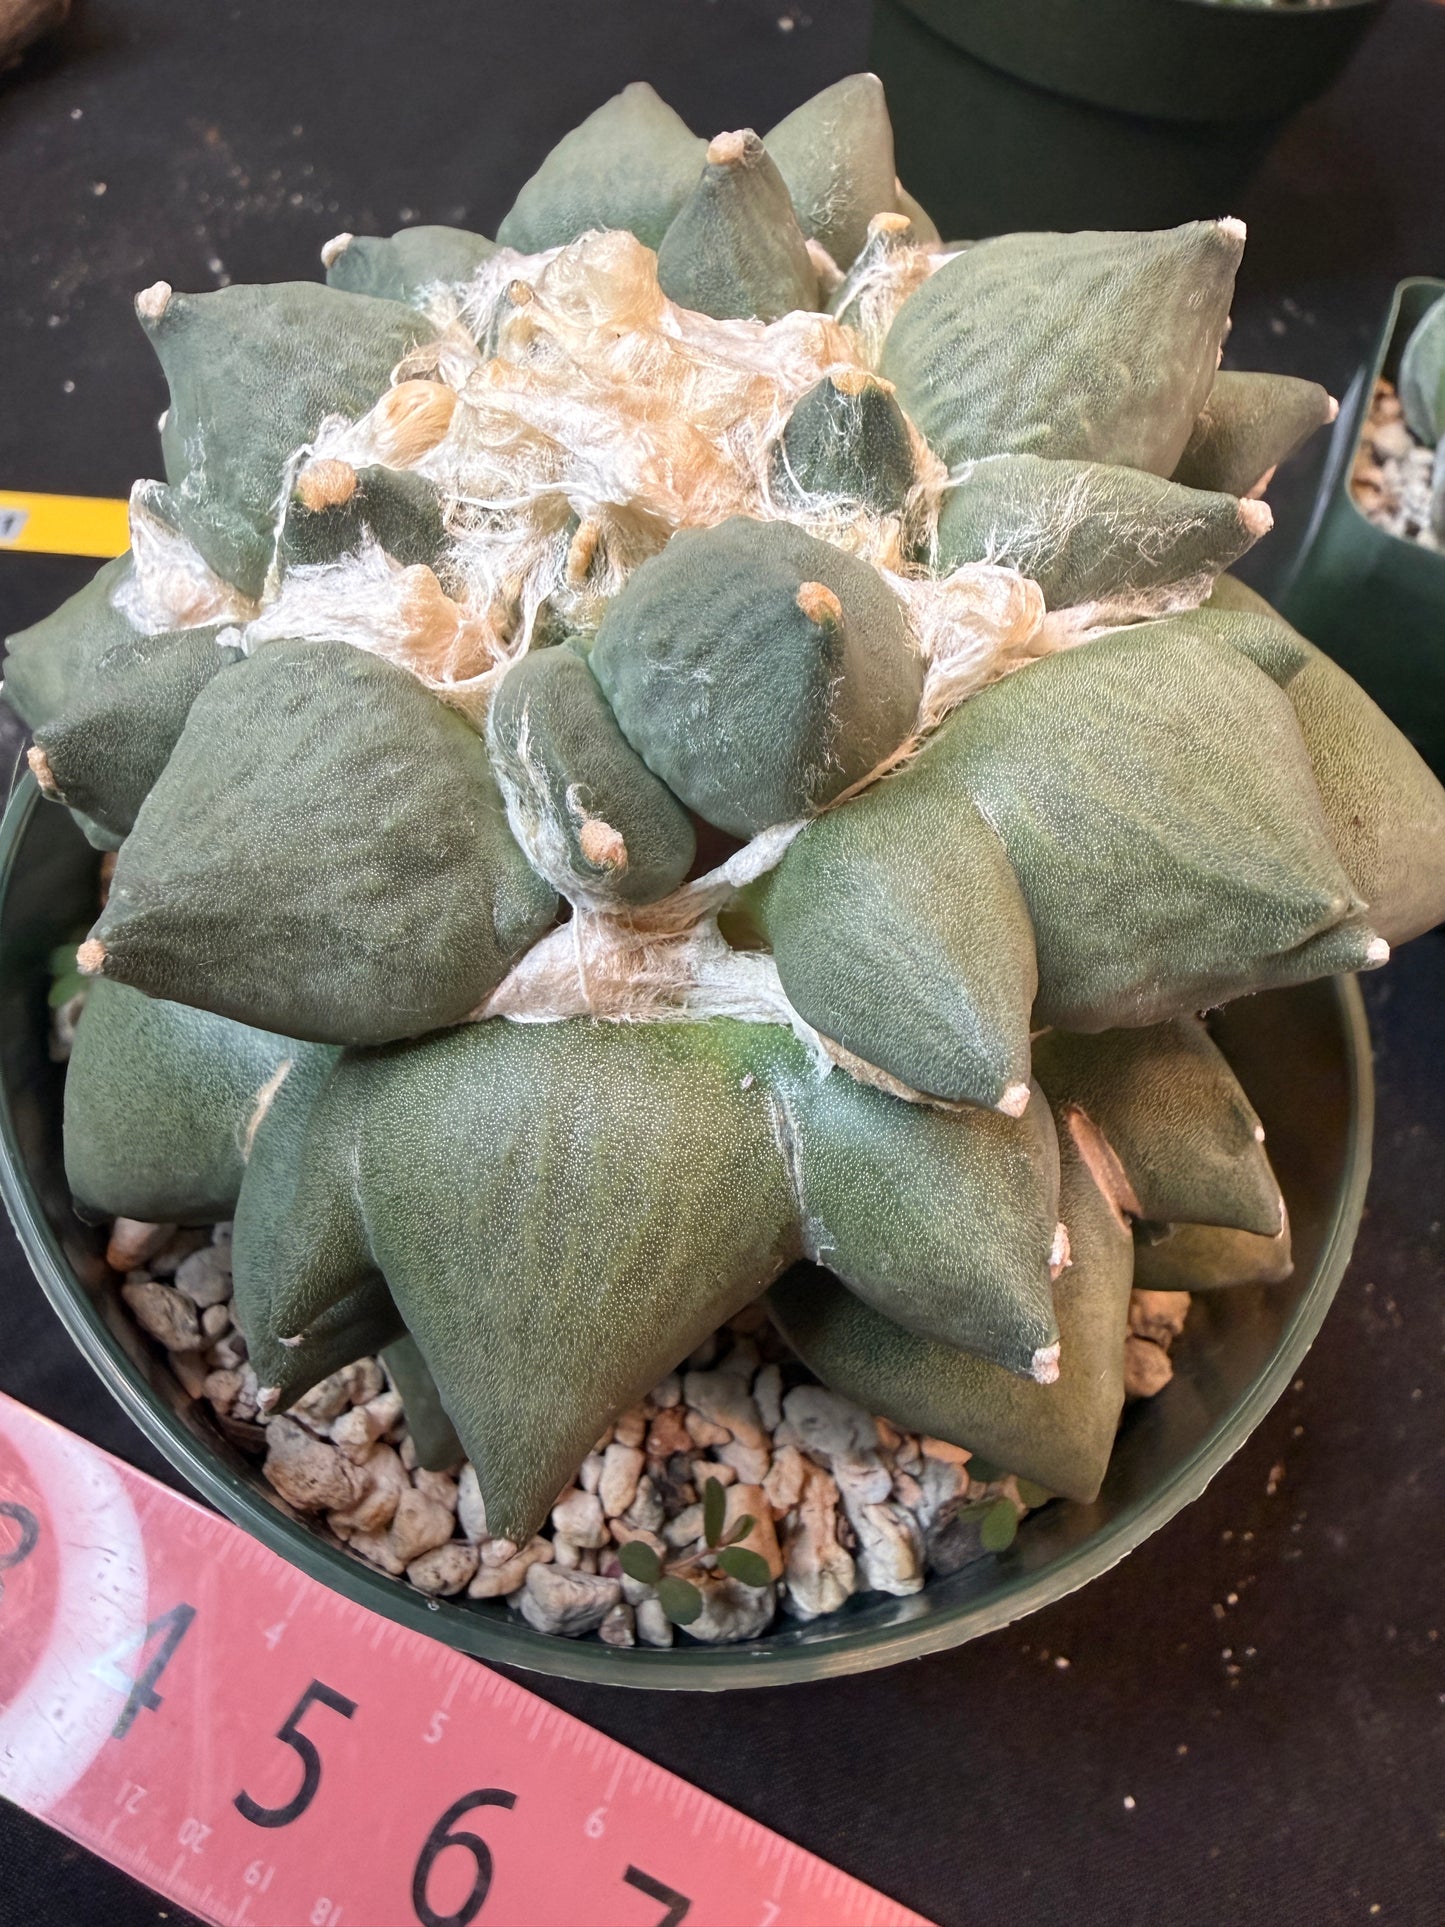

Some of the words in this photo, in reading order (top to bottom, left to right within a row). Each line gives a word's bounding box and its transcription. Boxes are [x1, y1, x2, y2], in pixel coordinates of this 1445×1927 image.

[88, 1602, 197, 1740] 4
[232, 1678, 358, 1829] 5
[411, 1787, 519, 1927] 6
[262, 1622, 287, 1650] 4
[422, 1713, 450, 1743] 5
[583, 1807, 608, 1838] 6
